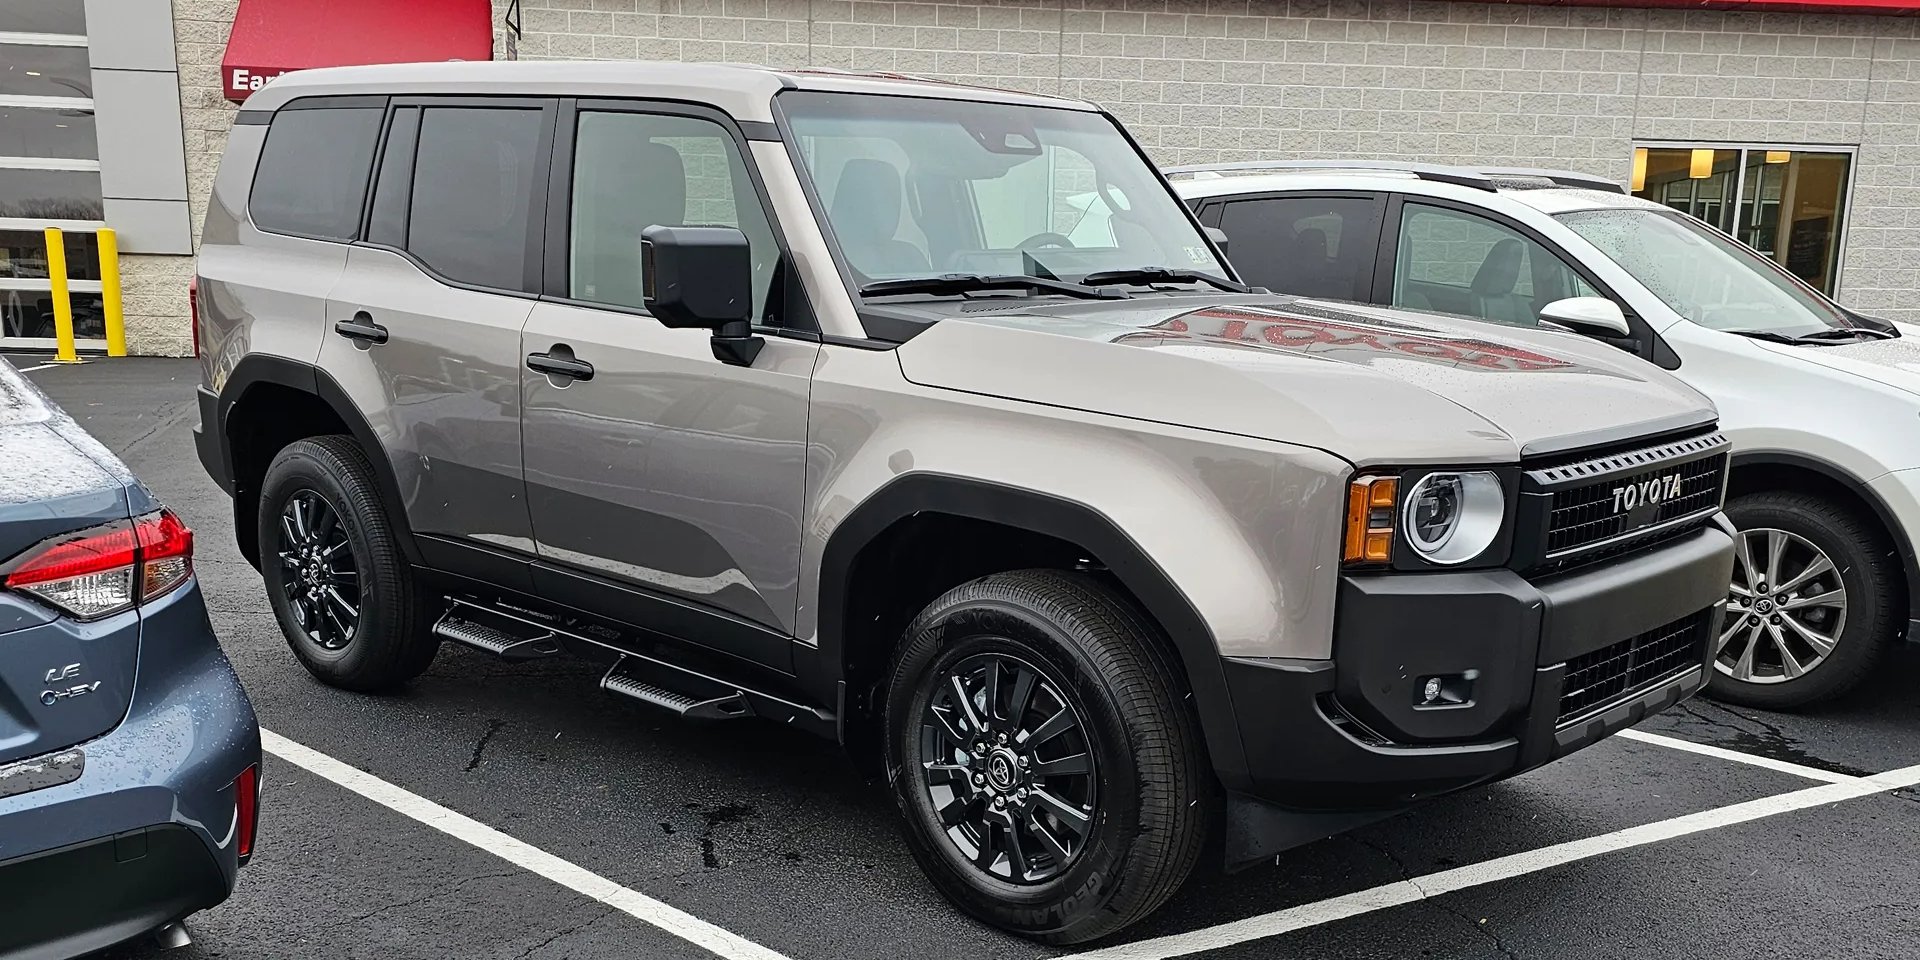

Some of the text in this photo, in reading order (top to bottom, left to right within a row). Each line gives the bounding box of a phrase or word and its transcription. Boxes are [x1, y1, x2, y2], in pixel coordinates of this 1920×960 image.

[232, 69, 286, 91] Ear
[1612, 473, 1681, 513] TOYOTA
[45, 662, 81, 685] LE
